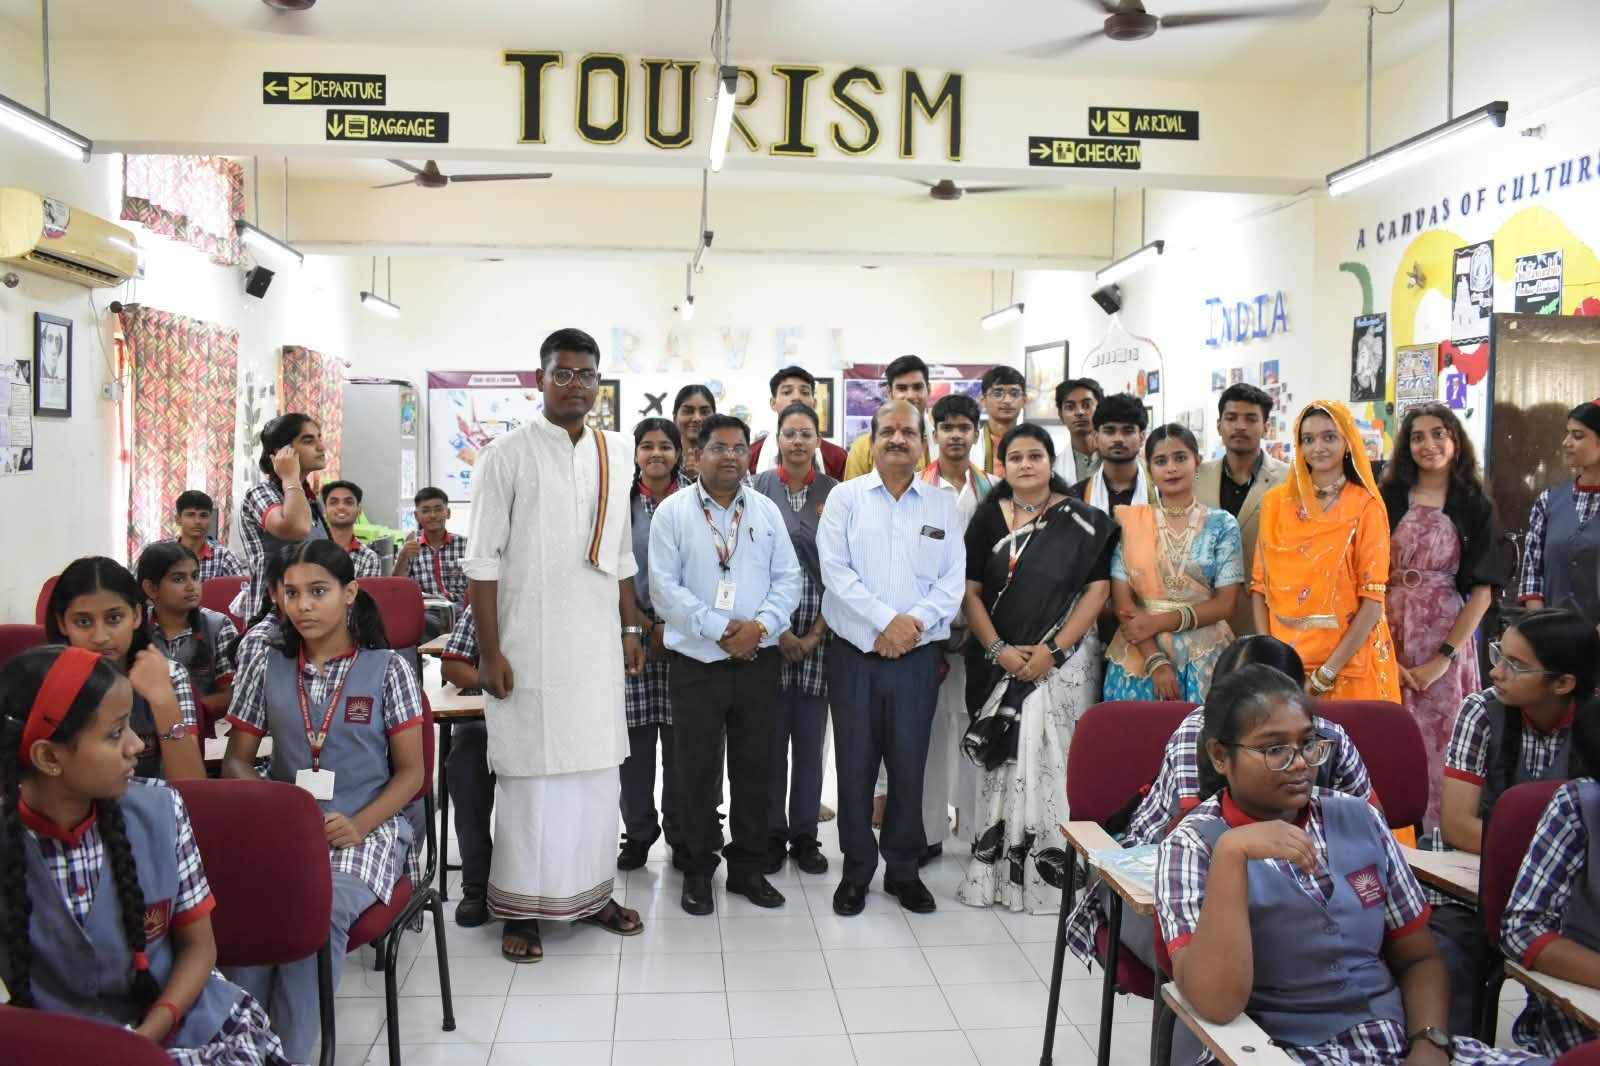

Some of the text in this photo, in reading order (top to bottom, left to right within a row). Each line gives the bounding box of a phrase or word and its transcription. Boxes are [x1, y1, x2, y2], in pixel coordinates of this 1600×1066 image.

[313, 80, 384, 99] DEPARTURE
[503, 50, 964, 162] TOURISM
[370, 118, 435, 138] BAGGAGE
[1135, 114, 1187, 133] ARRIVAL
[1075, 143, 1141, 163] CHECK-IN
[1356, 228, 1366, 250] A
[1461, 187, 1487, 216] OF
[1498, 150, 1600, 204] CULTUR
[1205, 290, 1288, 346] INDIA
[545, 326, 846, 373] RAVEL
